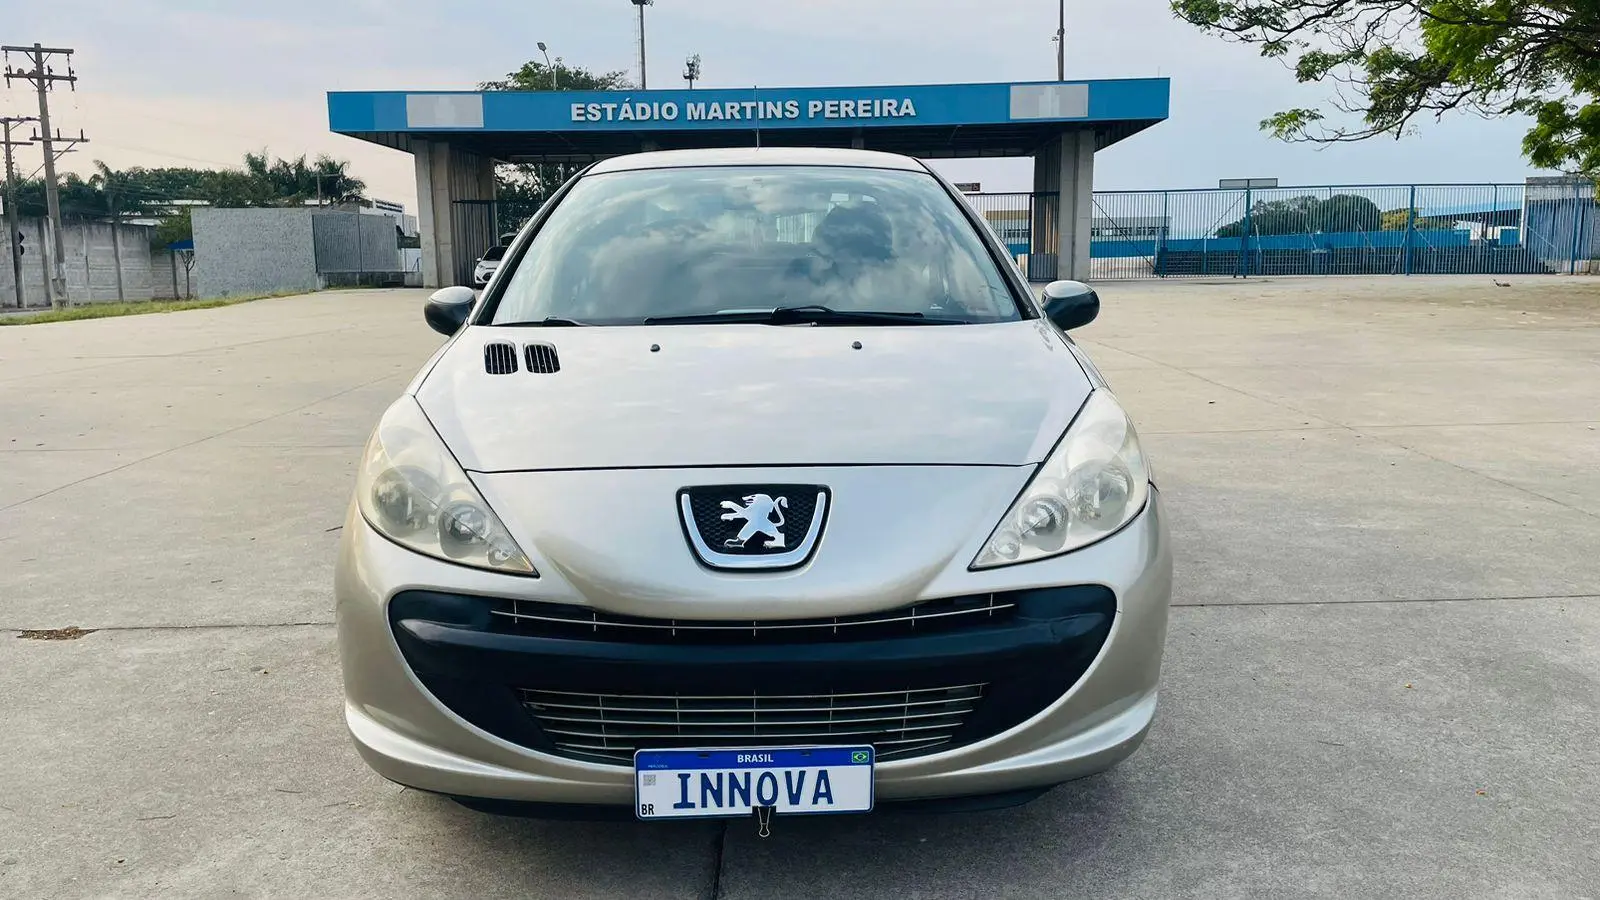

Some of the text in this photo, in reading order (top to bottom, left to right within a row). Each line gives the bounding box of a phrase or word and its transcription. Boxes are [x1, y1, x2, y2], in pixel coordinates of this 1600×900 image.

[570, 97, 917, 121] ESTÁDIO MARTINS PEREIRA
[737, 753, 774, 763] BRASIL
[673, 769, 834, 809] INNOVA
[641, 803, 655, 816] BR
